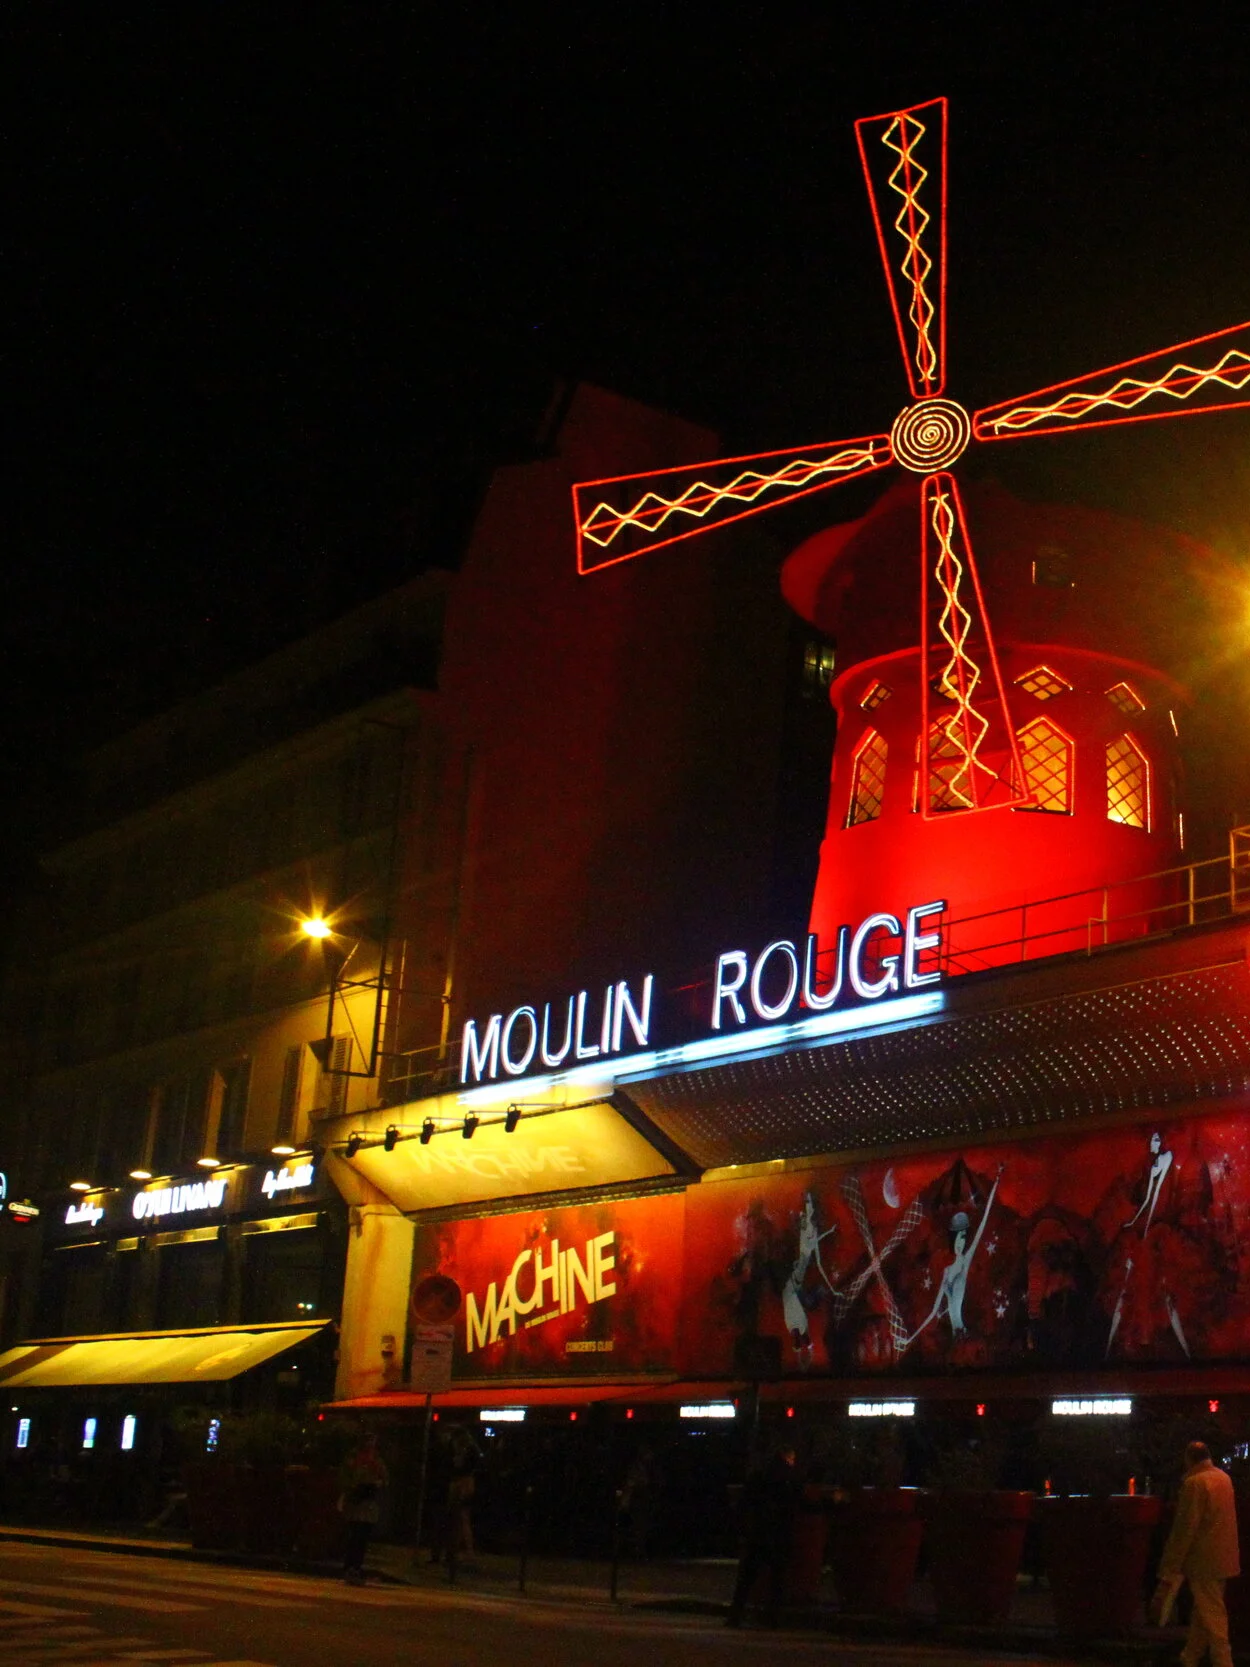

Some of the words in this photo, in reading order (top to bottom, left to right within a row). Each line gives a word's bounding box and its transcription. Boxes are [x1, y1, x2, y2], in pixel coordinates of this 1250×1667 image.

[460, 973, 654, 1083] MOULIN
[711, 899, 947, 1031] ROUGE
[465, 1230, 617, 1354] MACHINE
